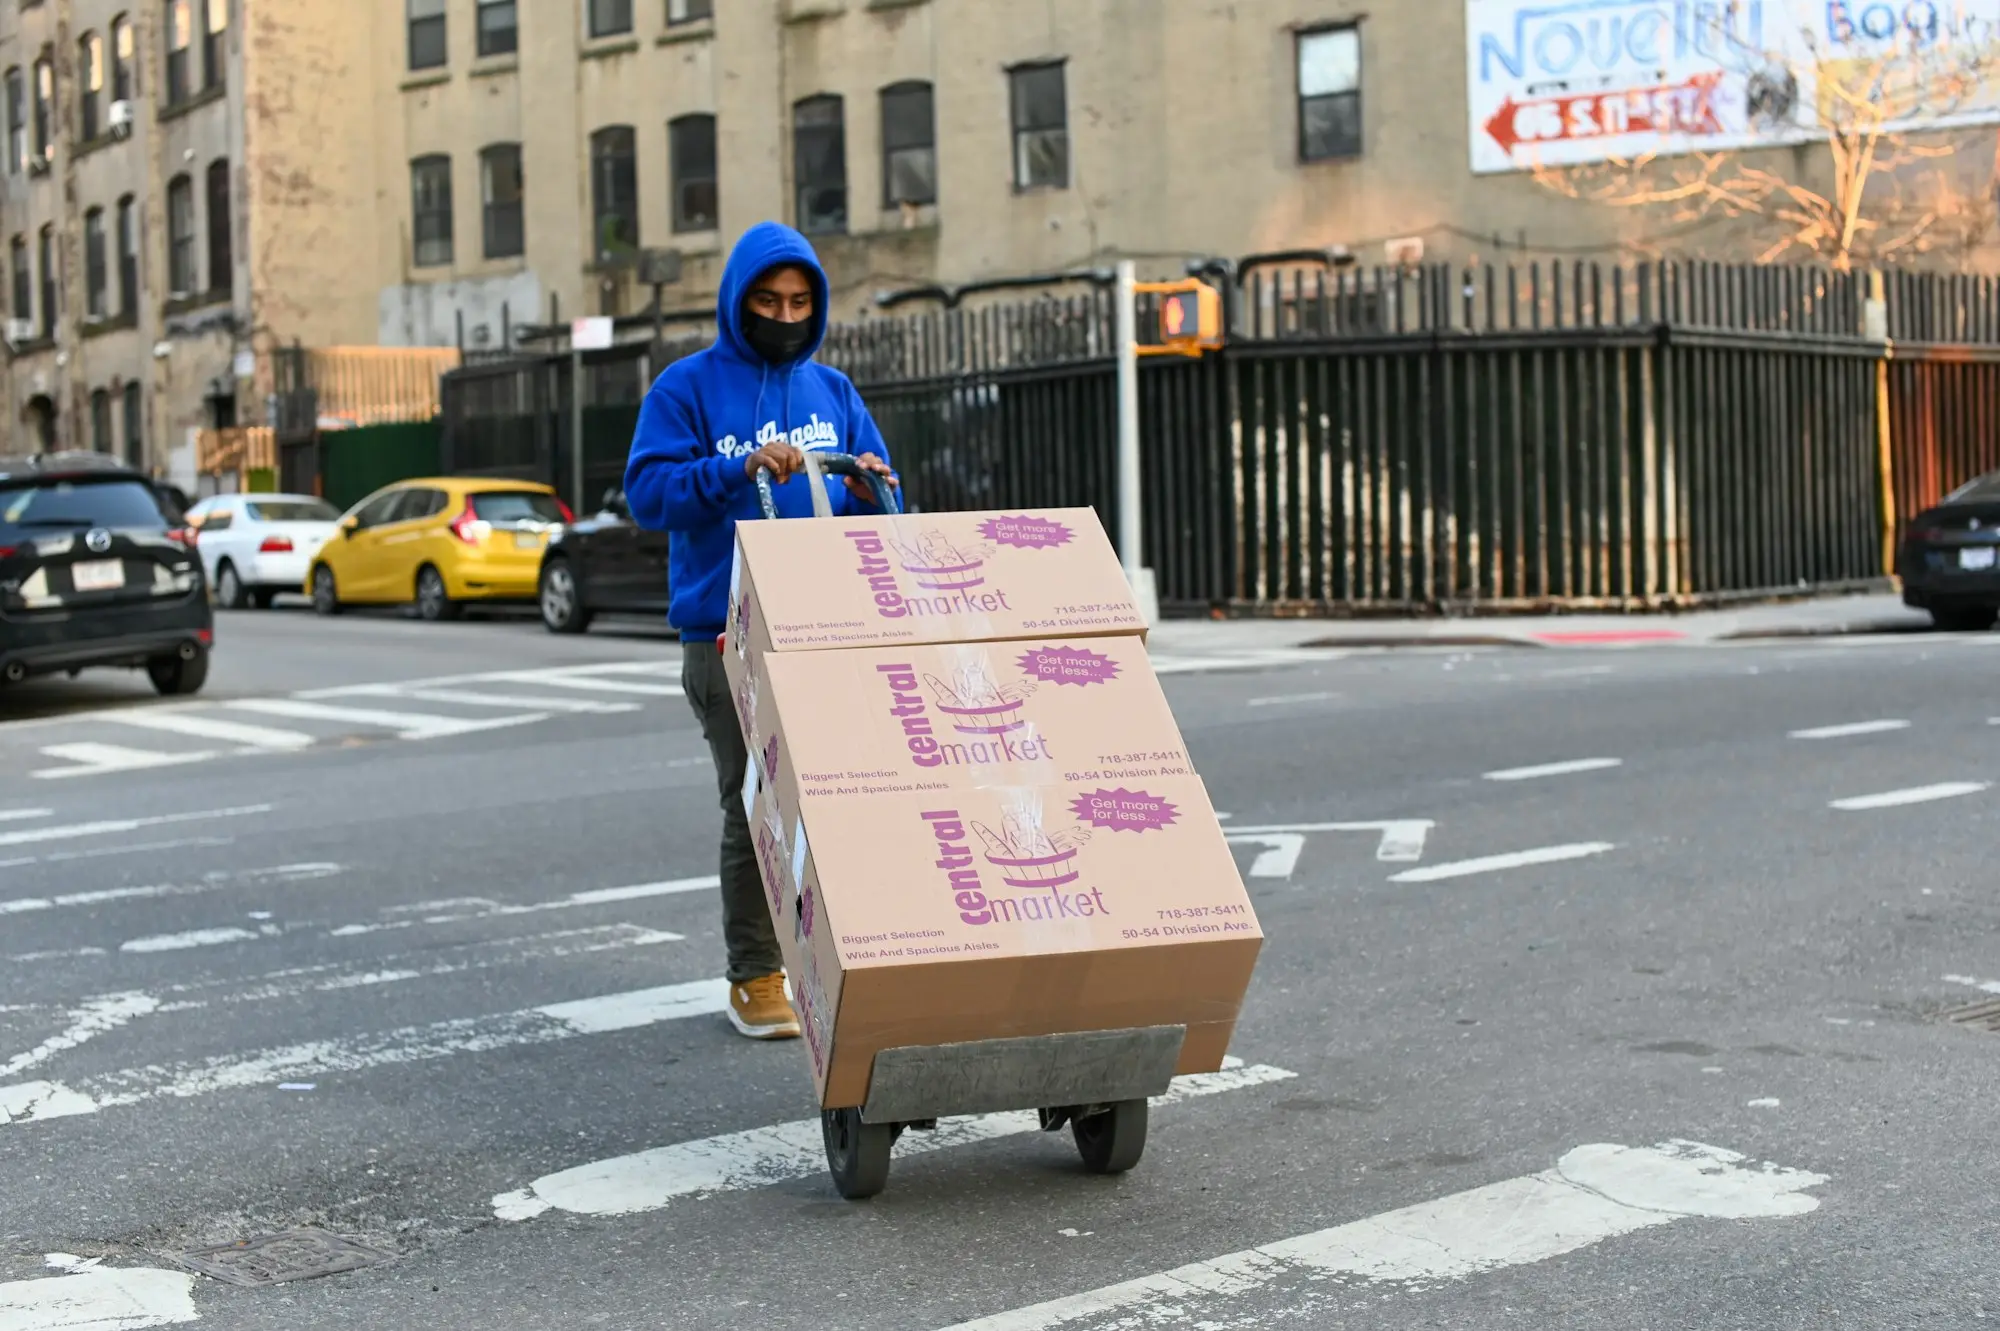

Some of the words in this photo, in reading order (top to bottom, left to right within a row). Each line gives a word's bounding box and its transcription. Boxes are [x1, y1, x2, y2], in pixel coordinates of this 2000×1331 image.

[716, 435, 755, 460] Los
[756, 413, 839, 453] Angeles
[844, 530, 906, 618] central
[903, 588, 1012, 617] market
[774, 623, 814, 632] Biggest
[817, 621, 865, 629] Selection
[1022, 620, 1056, 629] 50-54
[1059, 616, 1111, 627] Division
[776, 636, 804, 645] Wide
[807, 634, 828, 643] And
[831, 632, 879, 642] Spacious
[882, 630, 914, 638] Aisles
[1036, 655, 1062, 664] Get
[1066, 658, 1101, 667] more
[1038, 664, 1057, 674] for
[876, 663, 942, 767] central
[939, 733, 1053, 765] market
[1098, 751, 1181, 764] 718-387-5411
[801, 771, 844, 782] Biggest
[847, 768, 898, 779] Selection
[1064, 771, 1100, 782] 50-54
[1103, 767, 1157, 779] Division
[805, 788, 834, 796] Wide
[836, 786, 859, 795] And
[861, 783, 913, 795] Spacious
[915, 781, 950, 790] Aisles
[1090, 798, 1117, 809] Get
[1121, 800, 1159, 811] more
[1092, 808, 1112, 819] for
[920, 810, 992, 925] central
[988, 885, 1110, 923] market
[1157, 904, 1245, 920] 718-387-5411
[842, 932, 888, 945] Biggest
[890, 928, 945, 940] Selection
[1122, 927, 1160, 939] 50-54
[1162, 923, 1220, 936] Division
[1223, 921, 1253, 931] Ave.
[846, 951, 876, 961] Wide
[879, 948, 903, 958] And
[906, 945, 961, 957] Spacious
[963, 941, 1000, 951] Aisles
